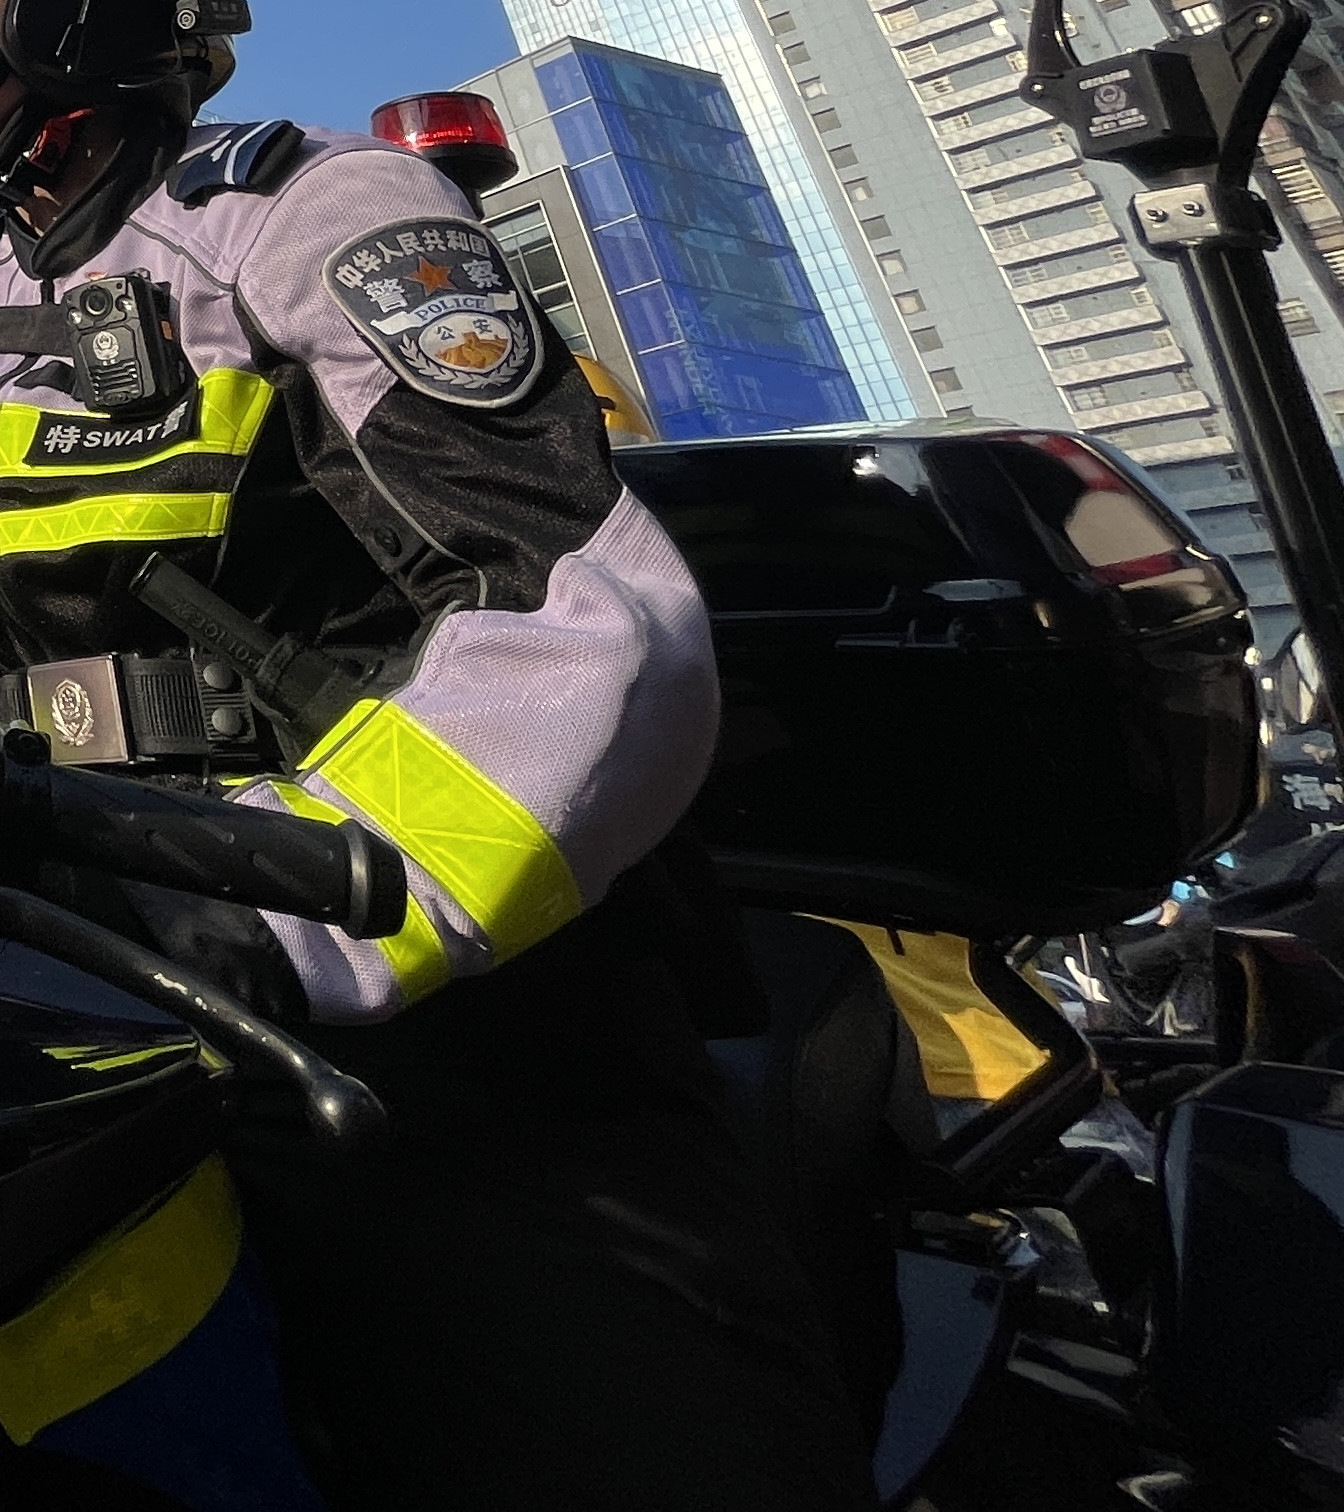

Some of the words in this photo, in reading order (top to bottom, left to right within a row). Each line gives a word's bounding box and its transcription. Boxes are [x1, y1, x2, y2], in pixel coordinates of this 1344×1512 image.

[335, 228, 491, 289] 中华人民共和国
[363, 277, 408, 313] 警
[462, 259, 503, 289] 察
[414, 296, 487, 322] POLICE
